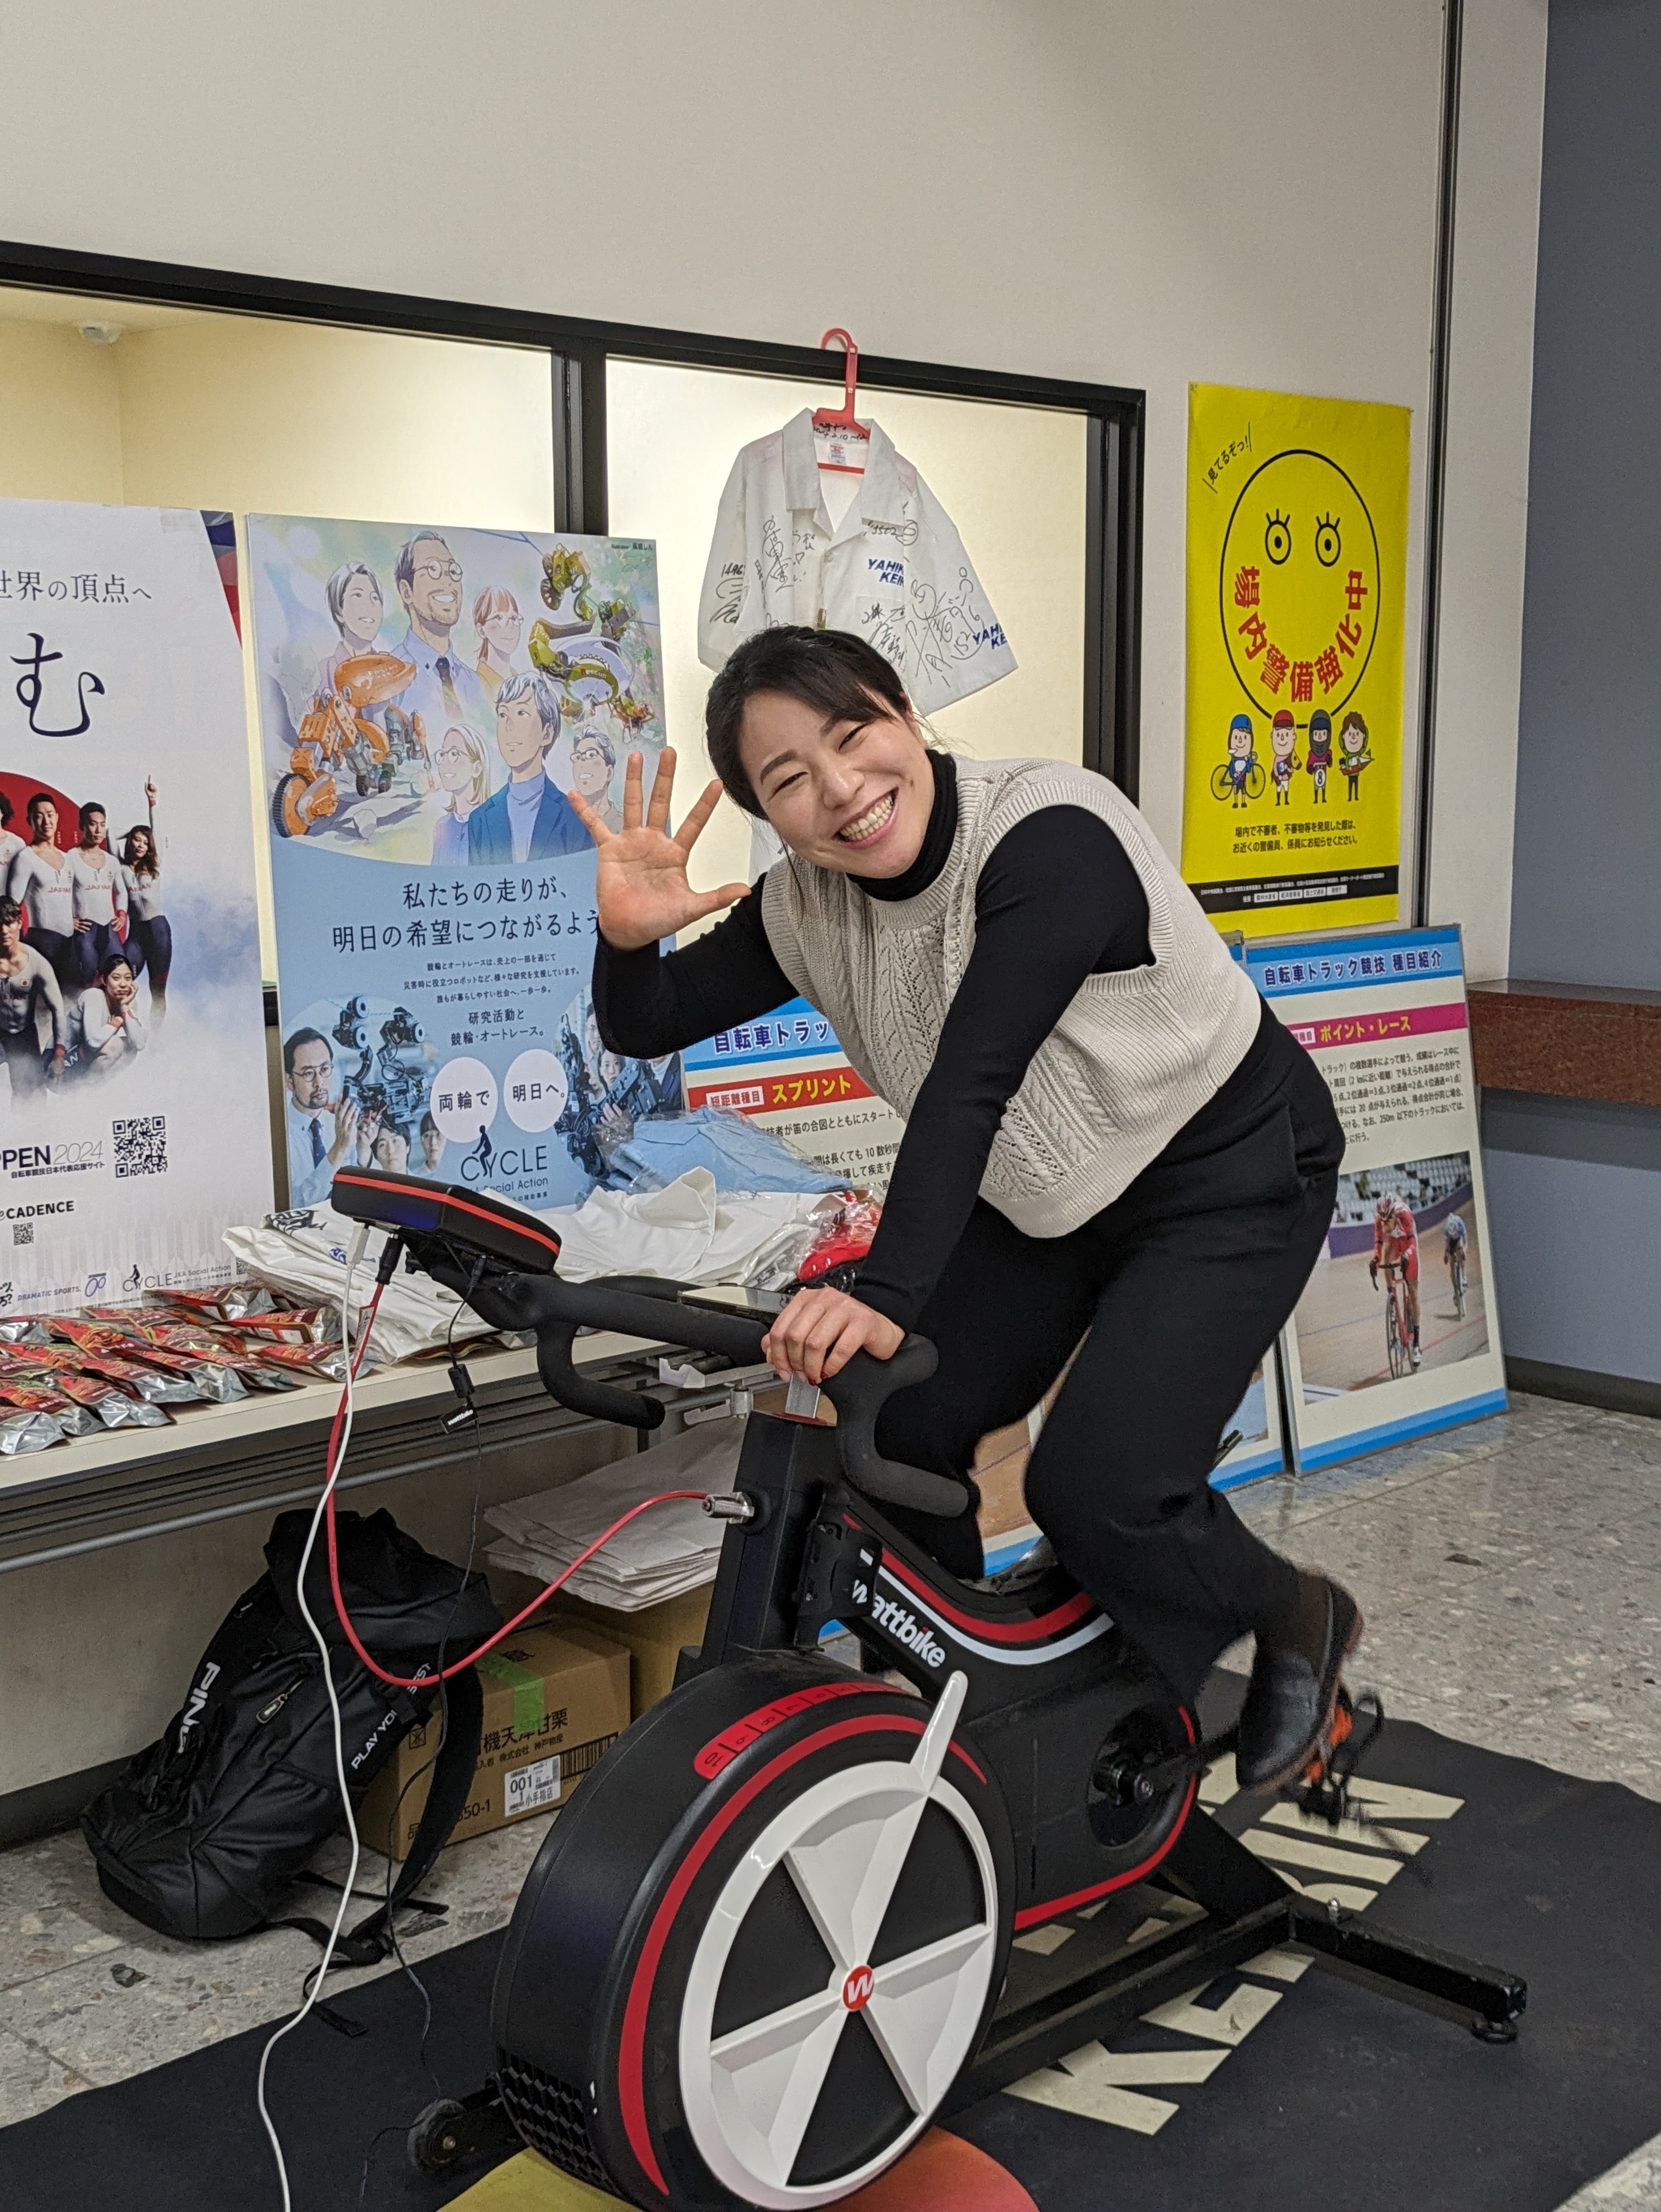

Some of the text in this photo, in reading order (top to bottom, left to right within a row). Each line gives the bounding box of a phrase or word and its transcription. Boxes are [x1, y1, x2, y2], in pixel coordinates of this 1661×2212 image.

[1234, 566, 1368, 702] 場内警備強化中
[10, 632, 105, 737] む
[1318, 771, 1323, 785] 8
[403, 876, 566, 910] 私たちの走りが、
[1264, 949, 1442, 986] 自転車トラック競技 種目紹介
[468, 1008, 524, 1025] 研究活動と
[451, 1025, 544, 1046] 競輪・オートレース。
[1320, 1016, 1411, 1043] ポイント・レース
[511, 1082, 566, 1102] 明日へ。
[772, 1074, 851, 1104] スプリント
[438, 1090, 490, 1113] 両輪で
[0, 1140, 103, 1170] PEN 2024
[460, 1145, 548, 1182] CYCLE
[11, 1161, 105, 1179] 自転車競技日本代表応援サイト
[518, 1177, 548, 1189] Action
[122, 1273, 173, 1292] CYCLE
[188, 1268, 209, 1276] Social
[17, 1290, 52, 1301] DRAMATIC
[351, 1732, 378, 1770] PLAY
[510, 1774, 532, 1794] 001
